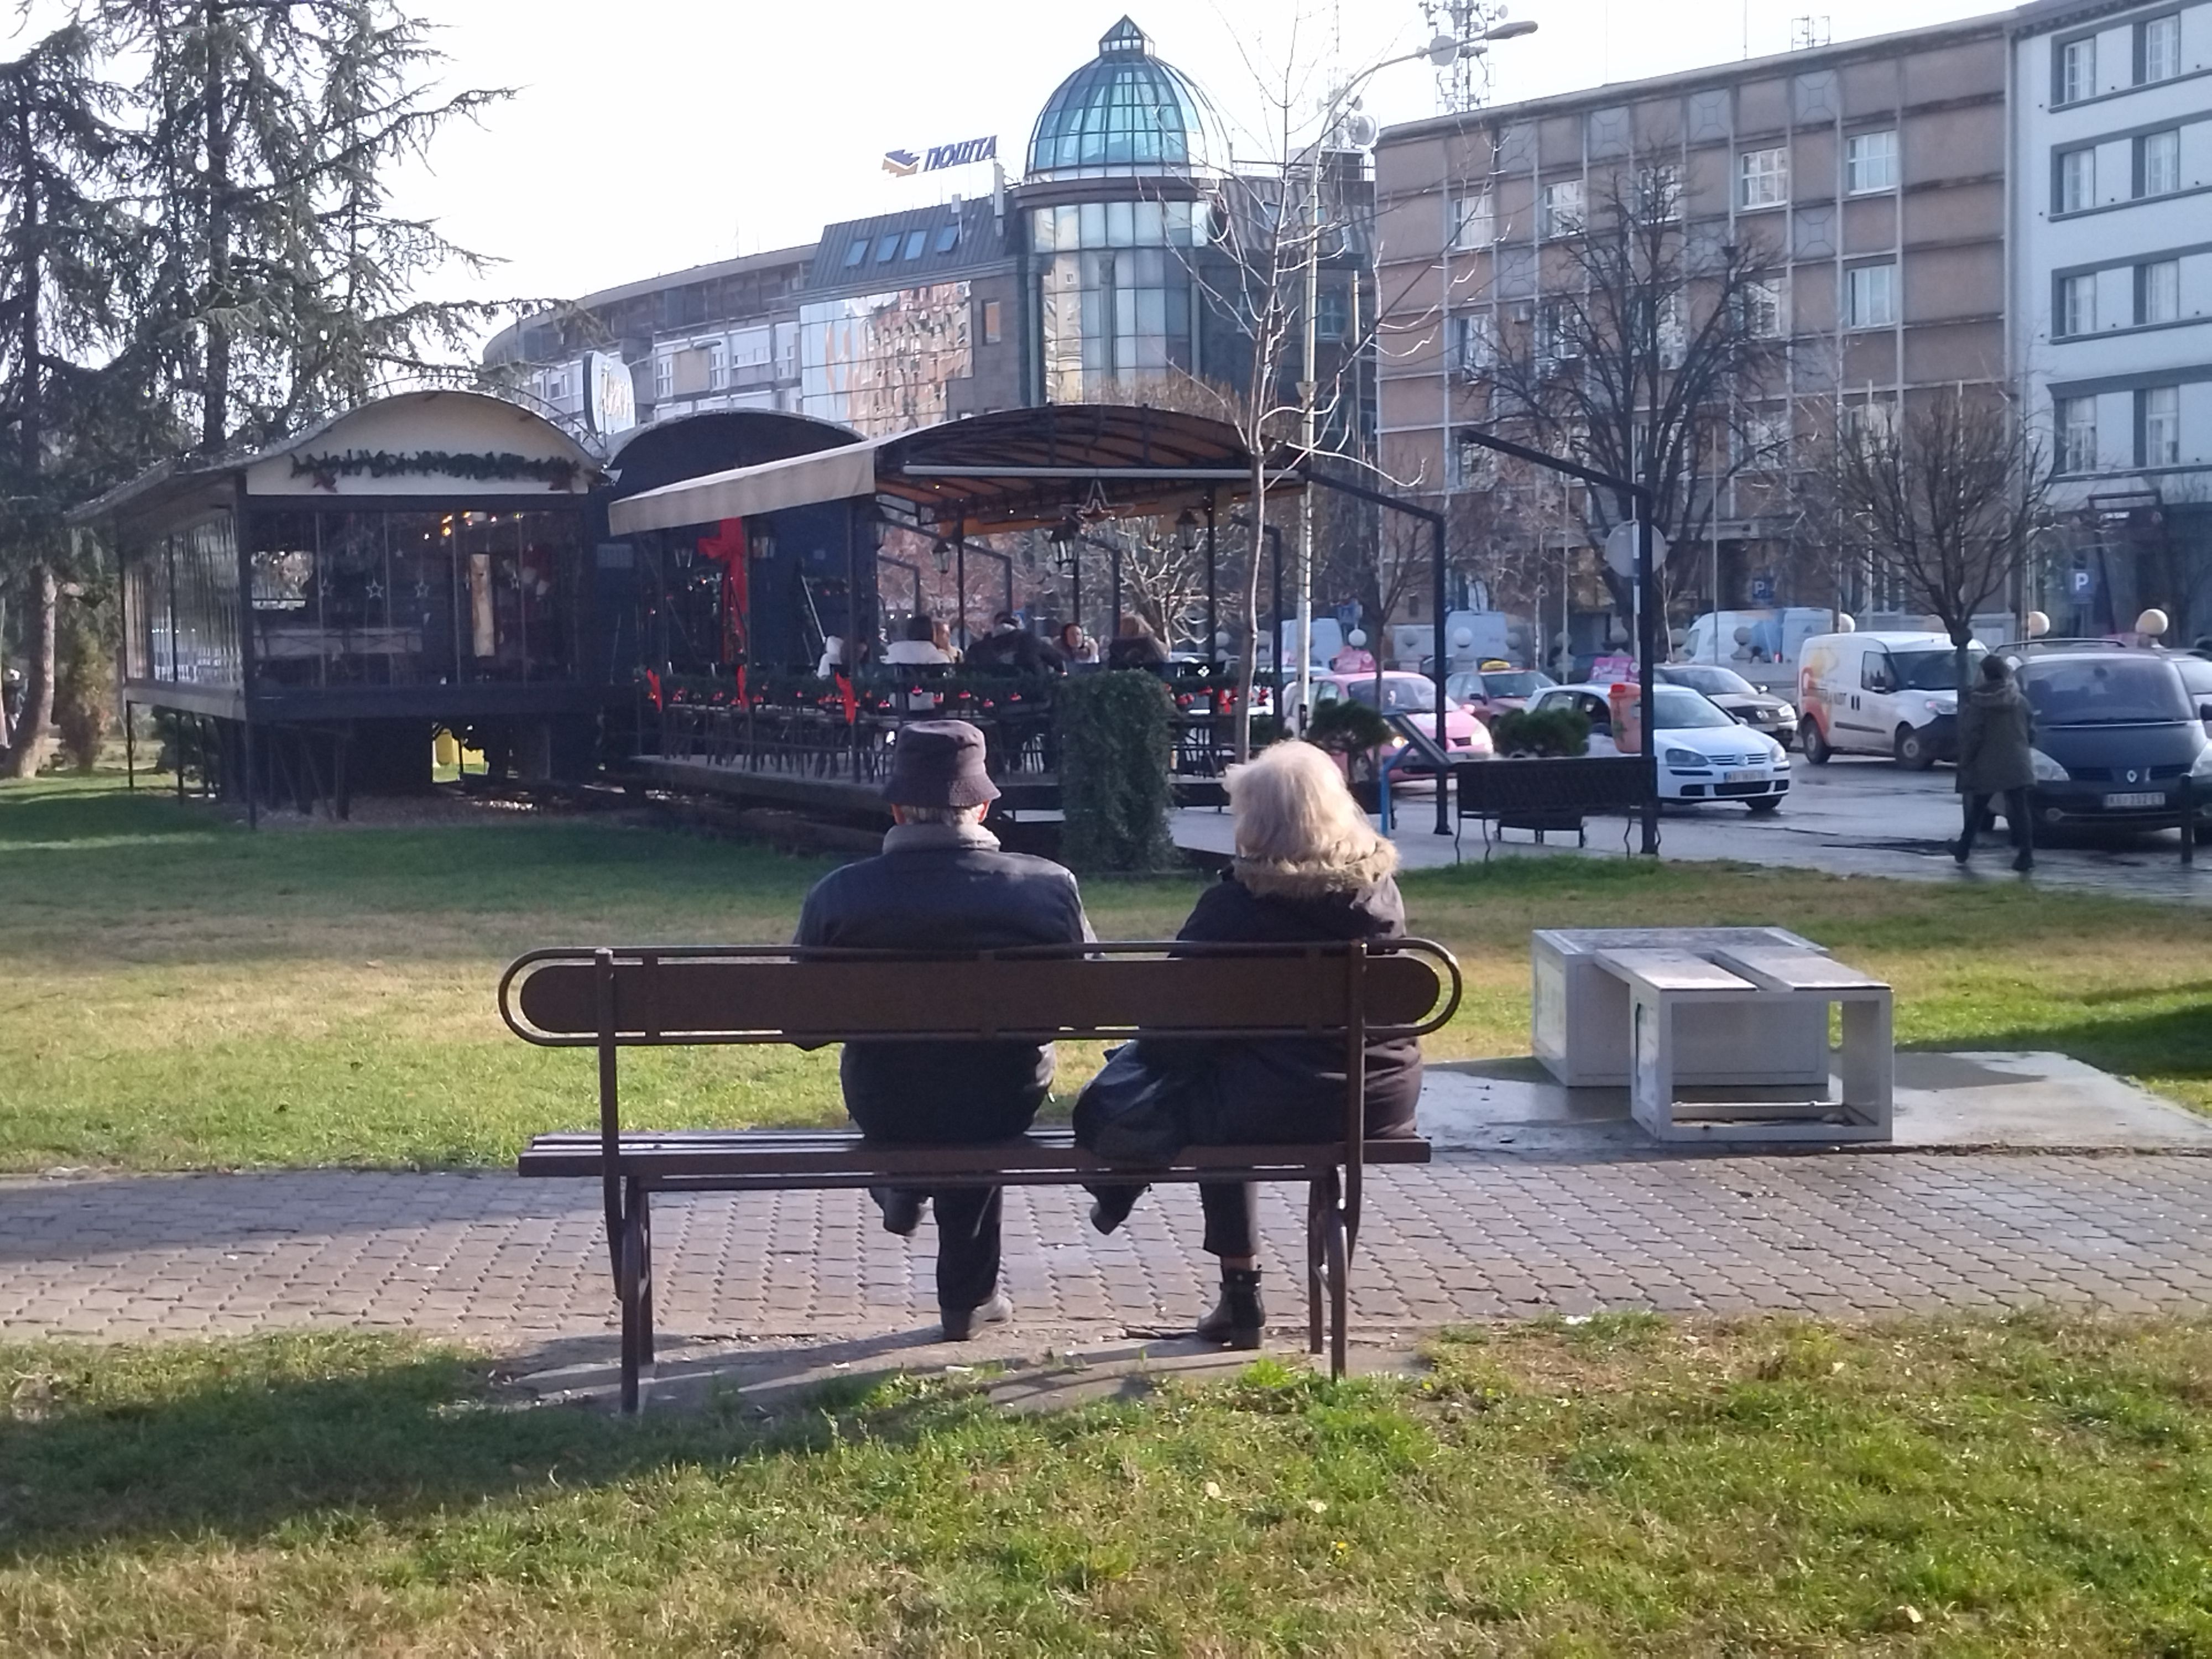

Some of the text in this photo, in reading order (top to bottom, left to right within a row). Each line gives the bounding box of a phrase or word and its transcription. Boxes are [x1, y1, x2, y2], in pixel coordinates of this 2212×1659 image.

[923, 135, 998, 172] ПОШТА
[1754, 581, 1765, 594] P
[2075, 573, 2089, 591] P
